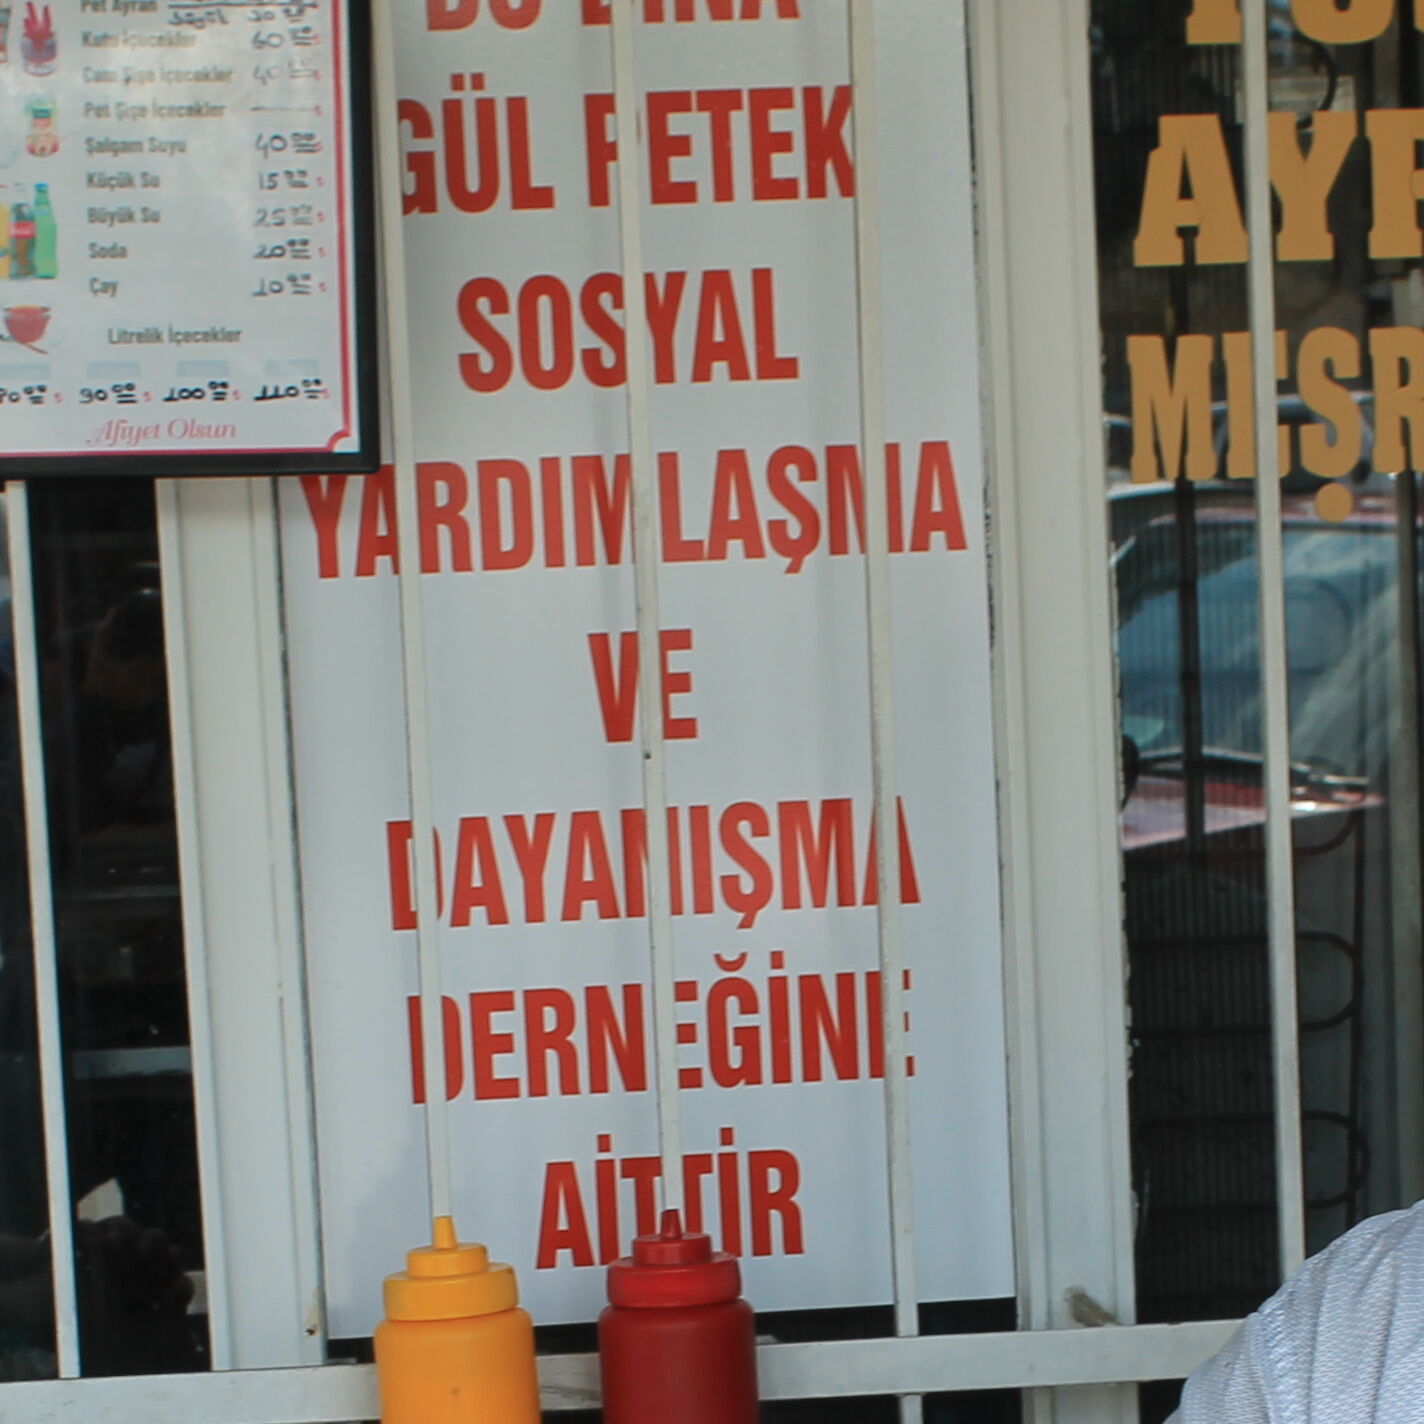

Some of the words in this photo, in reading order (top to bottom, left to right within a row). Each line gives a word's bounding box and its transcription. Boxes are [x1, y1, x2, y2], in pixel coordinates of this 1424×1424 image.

[140, 171, 161, 189] Su
[398, 73, 556, 216] GÜL
[583, 84, 855, 208] PETEK
[88, 242, 128, 259] Soda
[140, 206, 161, 224] Su
[89, 277, 119, 297] Çay
[108, 327, 165, 345] Litrelik
[458, 267, 800, 393] SOSYAL
[86, 418, 162, 447] Afiyet
[167, 417, 238, 441] Olsun
[301, 440, 968, 579] YARDIMLAŞMA
[587, 628, 698, 744] VE
[386, 796, 922, 931] DAYANIŞMA
[536, 1127, 805, 1271] AİTTİR
